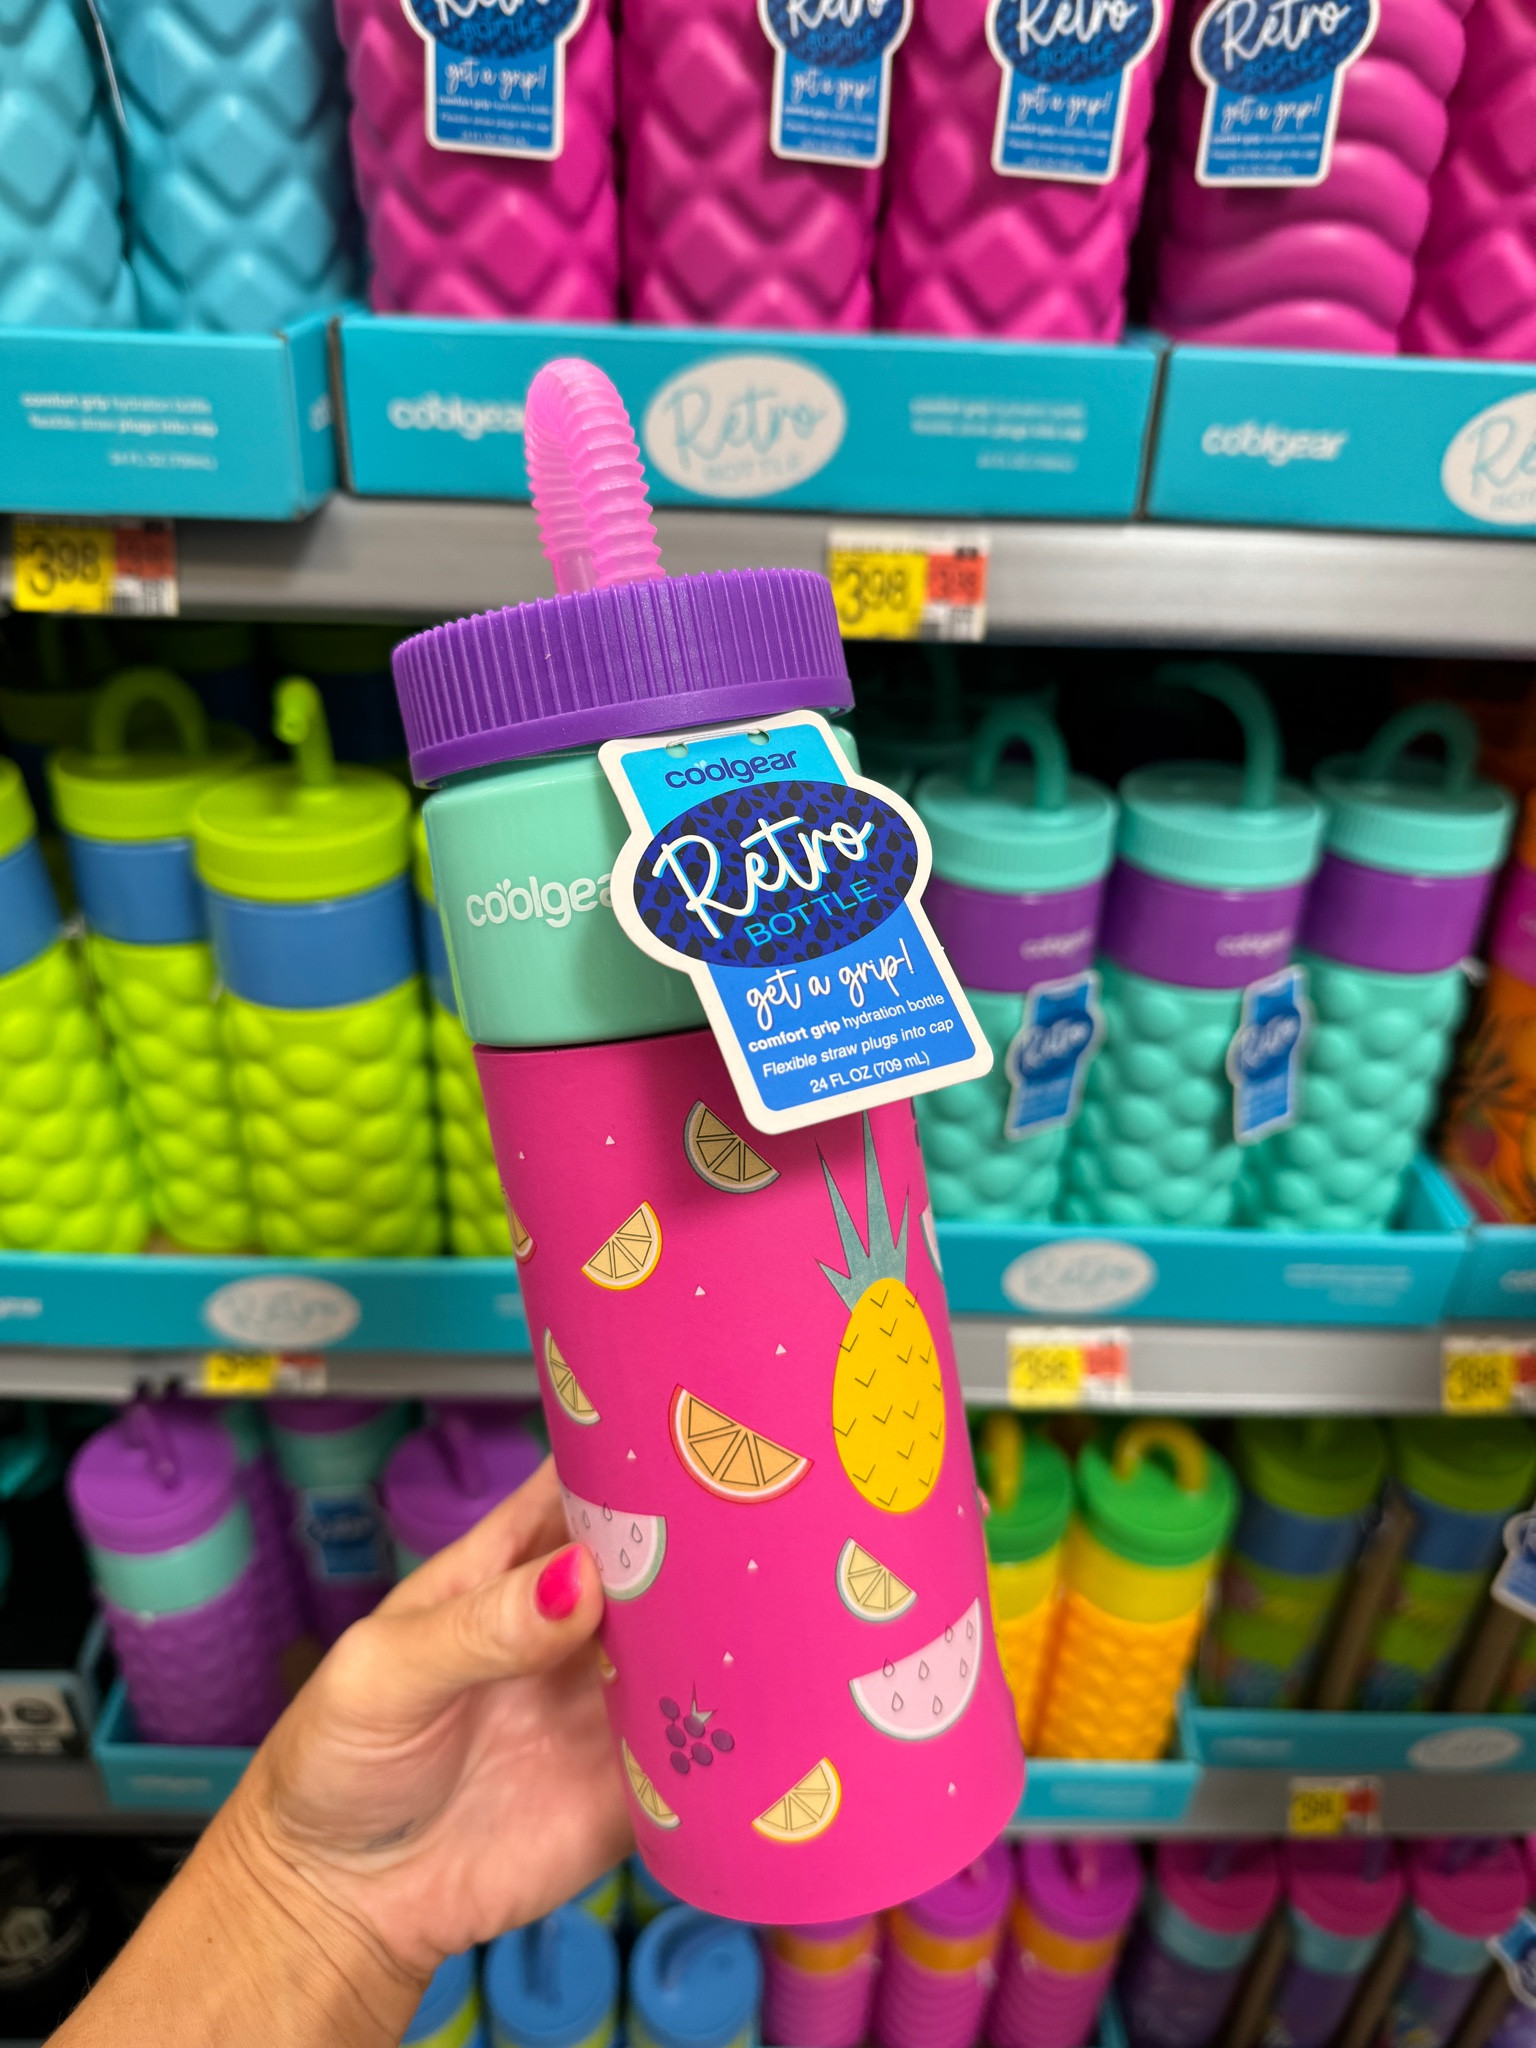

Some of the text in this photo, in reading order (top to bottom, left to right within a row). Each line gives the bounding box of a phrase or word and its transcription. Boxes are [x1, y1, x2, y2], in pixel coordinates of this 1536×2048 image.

[1215, 0, 1351, 71] Retro
[386, 391, 525, 441] coolgea
[660, 383, 828, 471] Retro
[665, 750, 797, 788] coolgear
[466, 875, 612, 928] coolgea
[651, 815, 874, 940] Retro
[744, 879, 877, 947] BOTTLE
[746, 937, 915, 1031] get a grip!
[748, 993, 945, 1052] comfort grip hydration bottle
[762, 1019, 954, 1078] Flexible straw plugs into cap
[809, 1050, 931, 1093] 24 FL OZ (709 mL)
